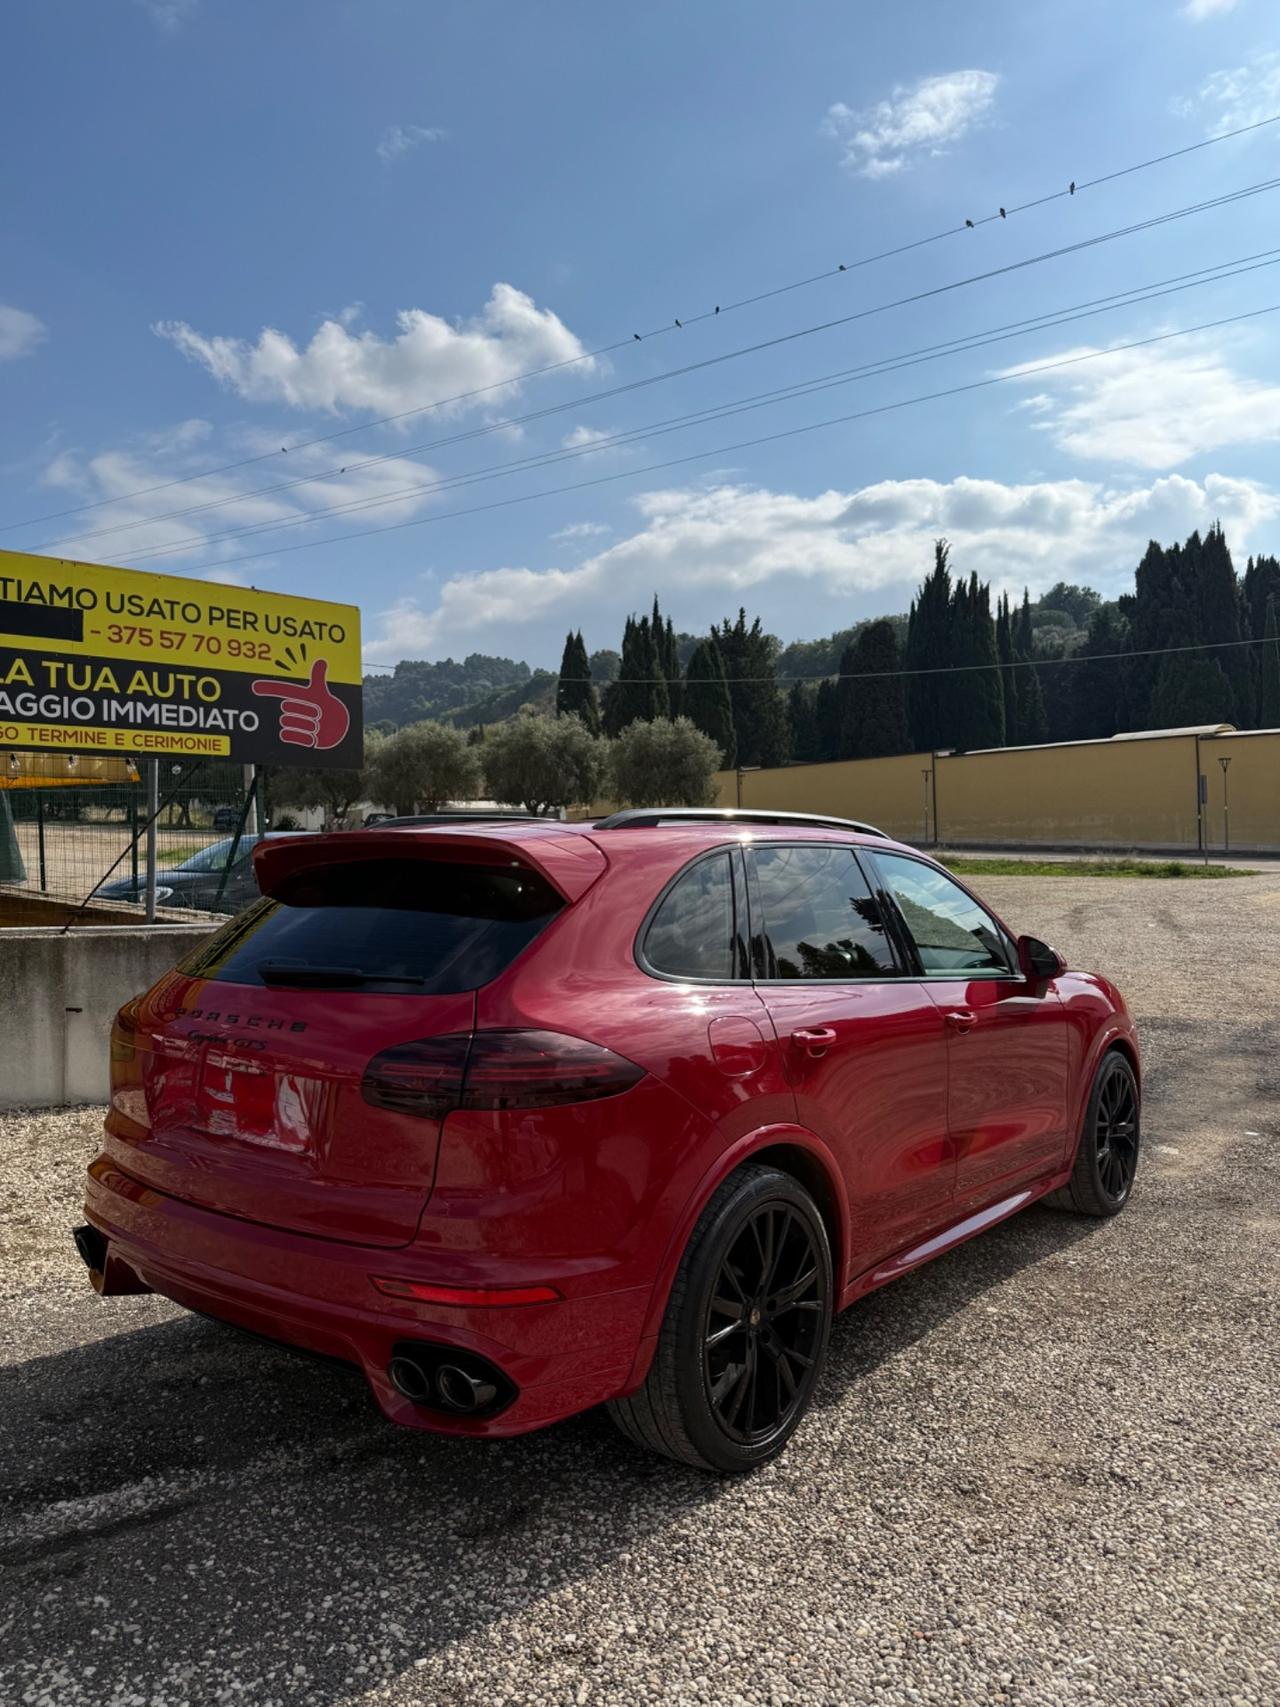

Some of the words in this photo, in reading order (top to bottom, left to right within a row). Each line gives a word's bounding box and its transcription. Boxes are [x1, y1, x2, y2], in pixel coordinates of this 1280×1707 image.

[0, 577, 97, 610] TIAMO
[106, 592, 202, 624] USATO
[209, 606, 259, 632] PER
[265, 614, 346, 643] USATO
[107, 624, 153, 647] 375
[160, 630, 186, 650] 57
[192, 634, 221, 655] 70
[228, 639, 272, 661] 932
[0, 658, 35, 686] A
[41, 661, 121, 694] TUA
[126, 670, 221, 702] AUTO
[0, 691, 95, 720] AGGIO
[103, 699, 259, 732] IMMEDIATO
[0, 726, 19, 740] O
[27, 727, 107, 745] TERMINE
[115, 733, 125, 746] E
[132, 734, 222, 751] CERIMONIE
[175, 1007, 308, 1032] PORSCHE
